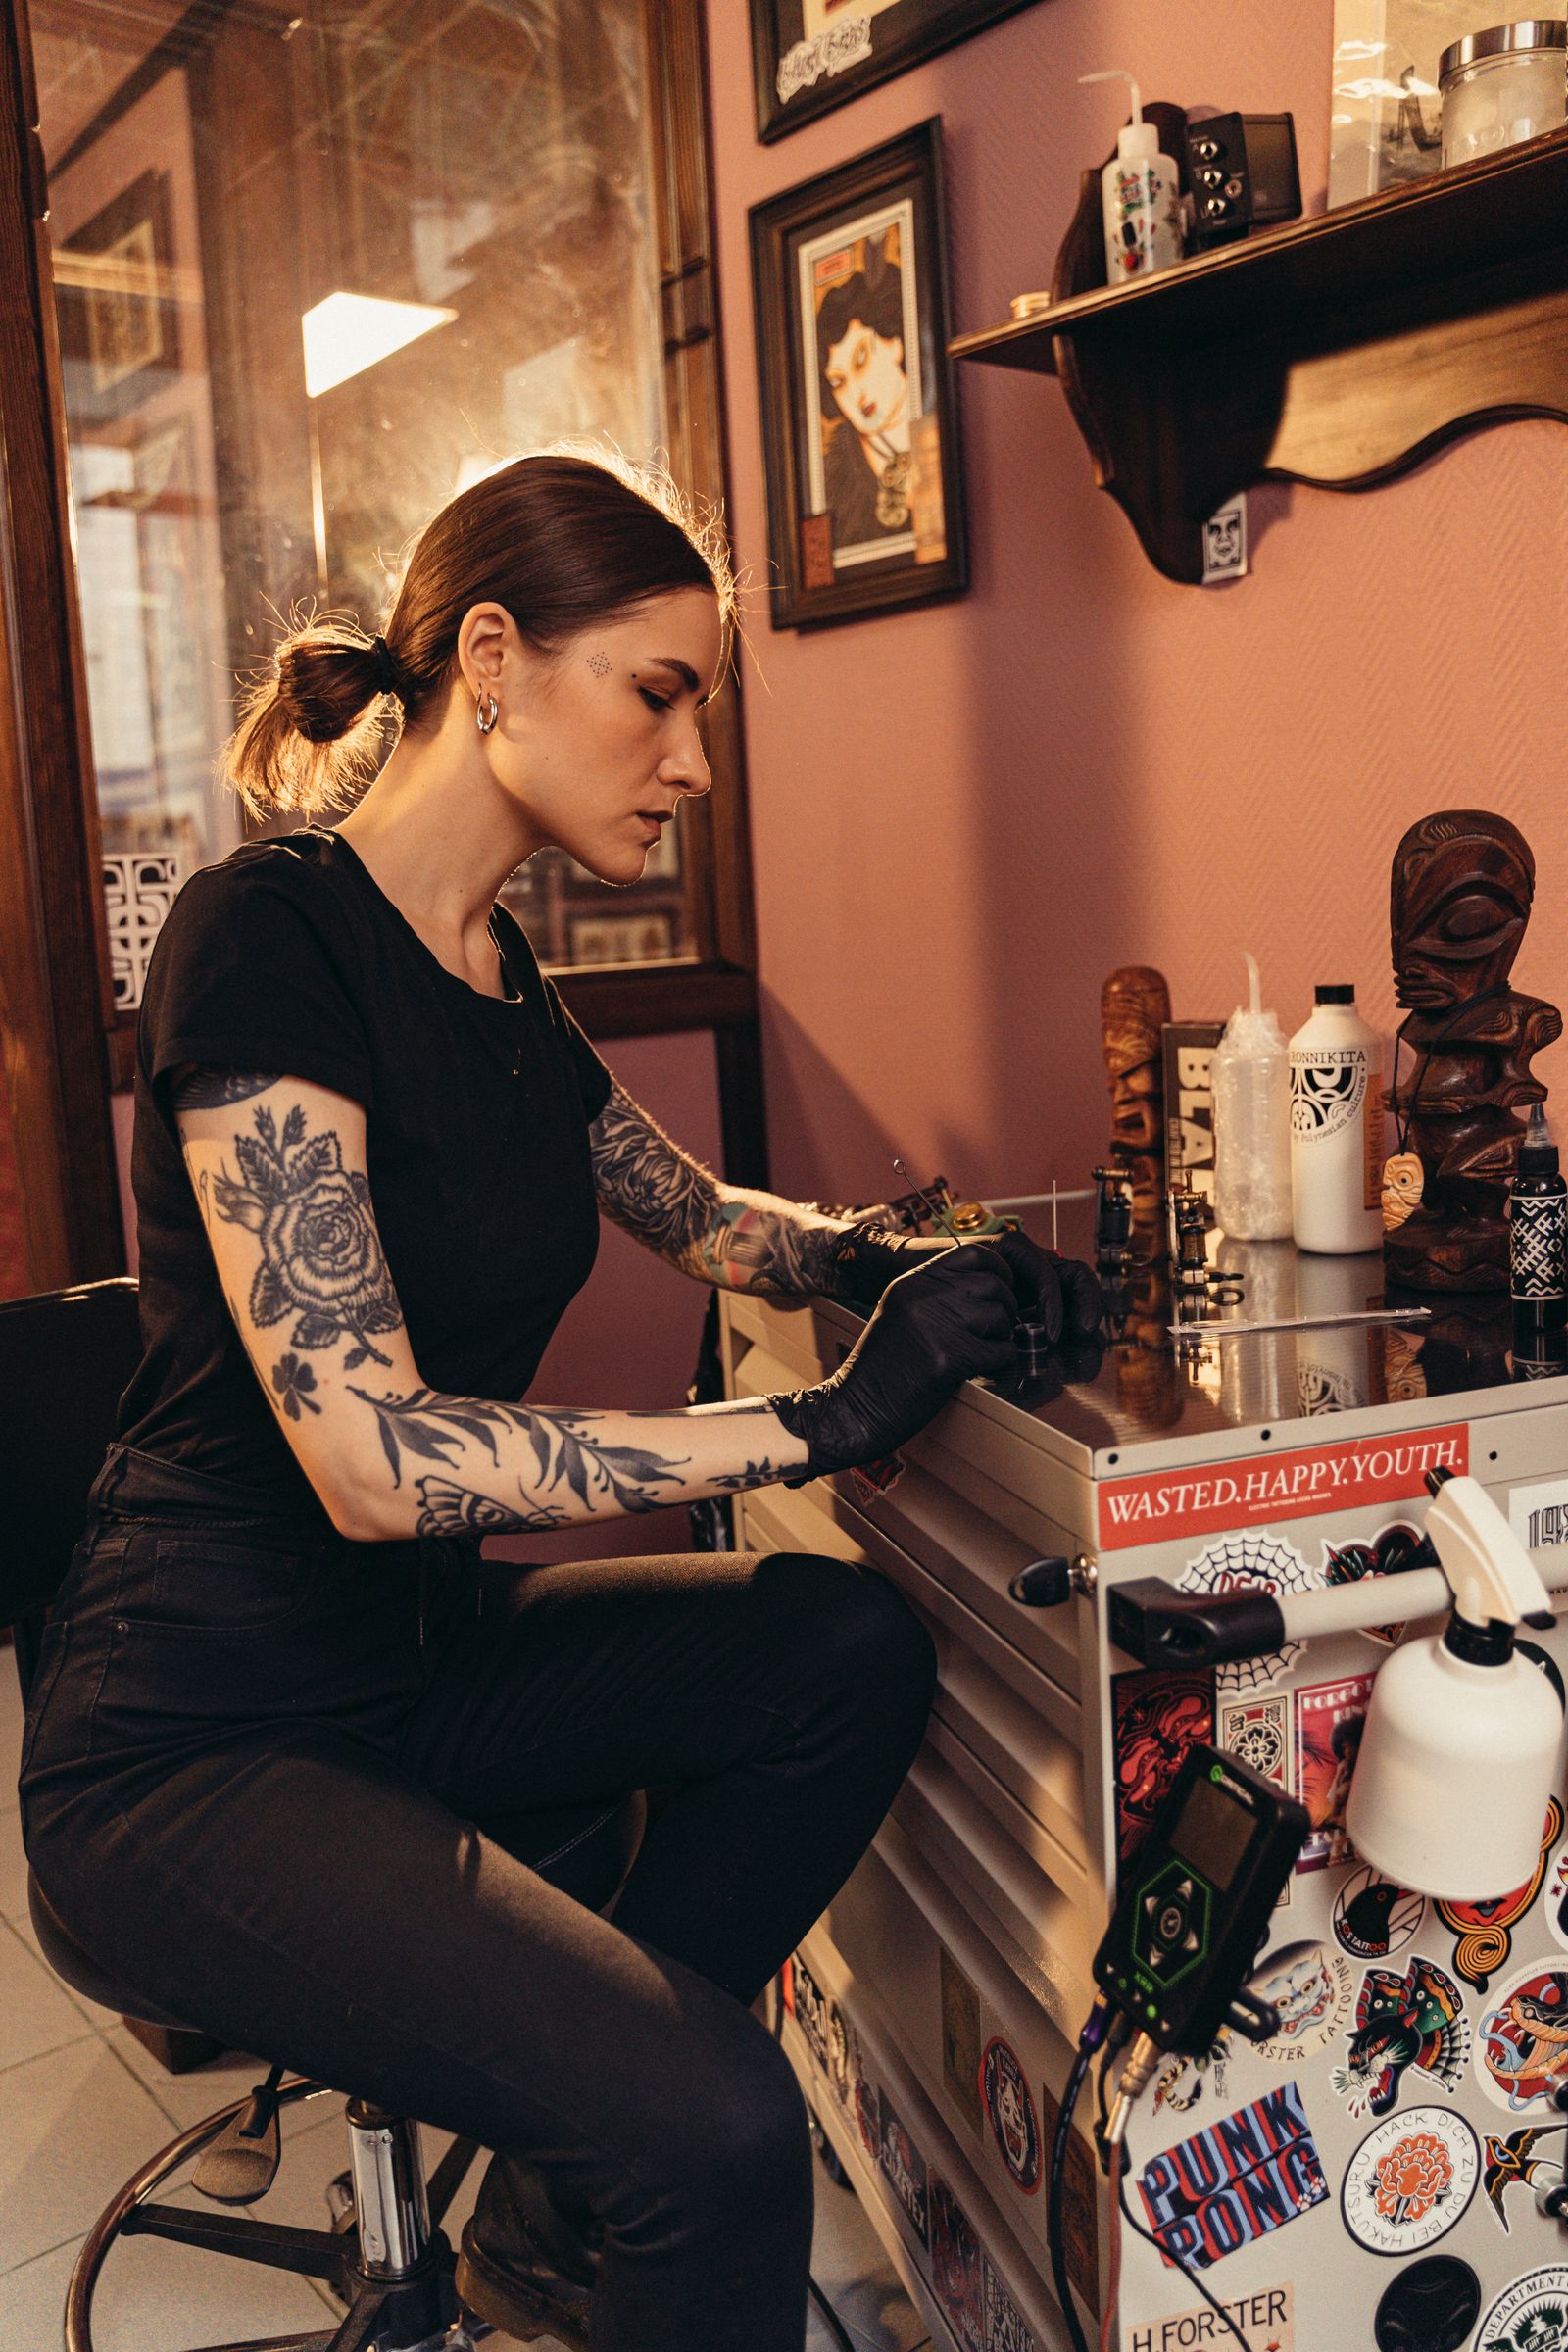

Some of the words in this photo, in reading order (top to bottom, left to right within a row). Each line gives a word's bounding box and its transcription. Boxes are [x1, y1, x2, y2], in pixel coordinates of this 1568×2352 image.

[1347, 1075, 1366, 1118] culture
[1350, 1937, 1388, 1953] TATTOO
[1375, 2111, 1428, 2144] HACK
[1437, 2113, 1471, 2149] DICH
[1136, 2080, 1311, 2233] PUNK
[1460, 2155, 1474, 2184] ZU
[1152, 2135, 1331, 2270] PONG
[1348, 2151, 1404, 2247] HAKUTSURU
[1445, 2192, 1467, 2219] DU
[1412, 2219, 1444, 2244] BEI
[1485, 2275, 1565, 2339] DEPARTMENT
